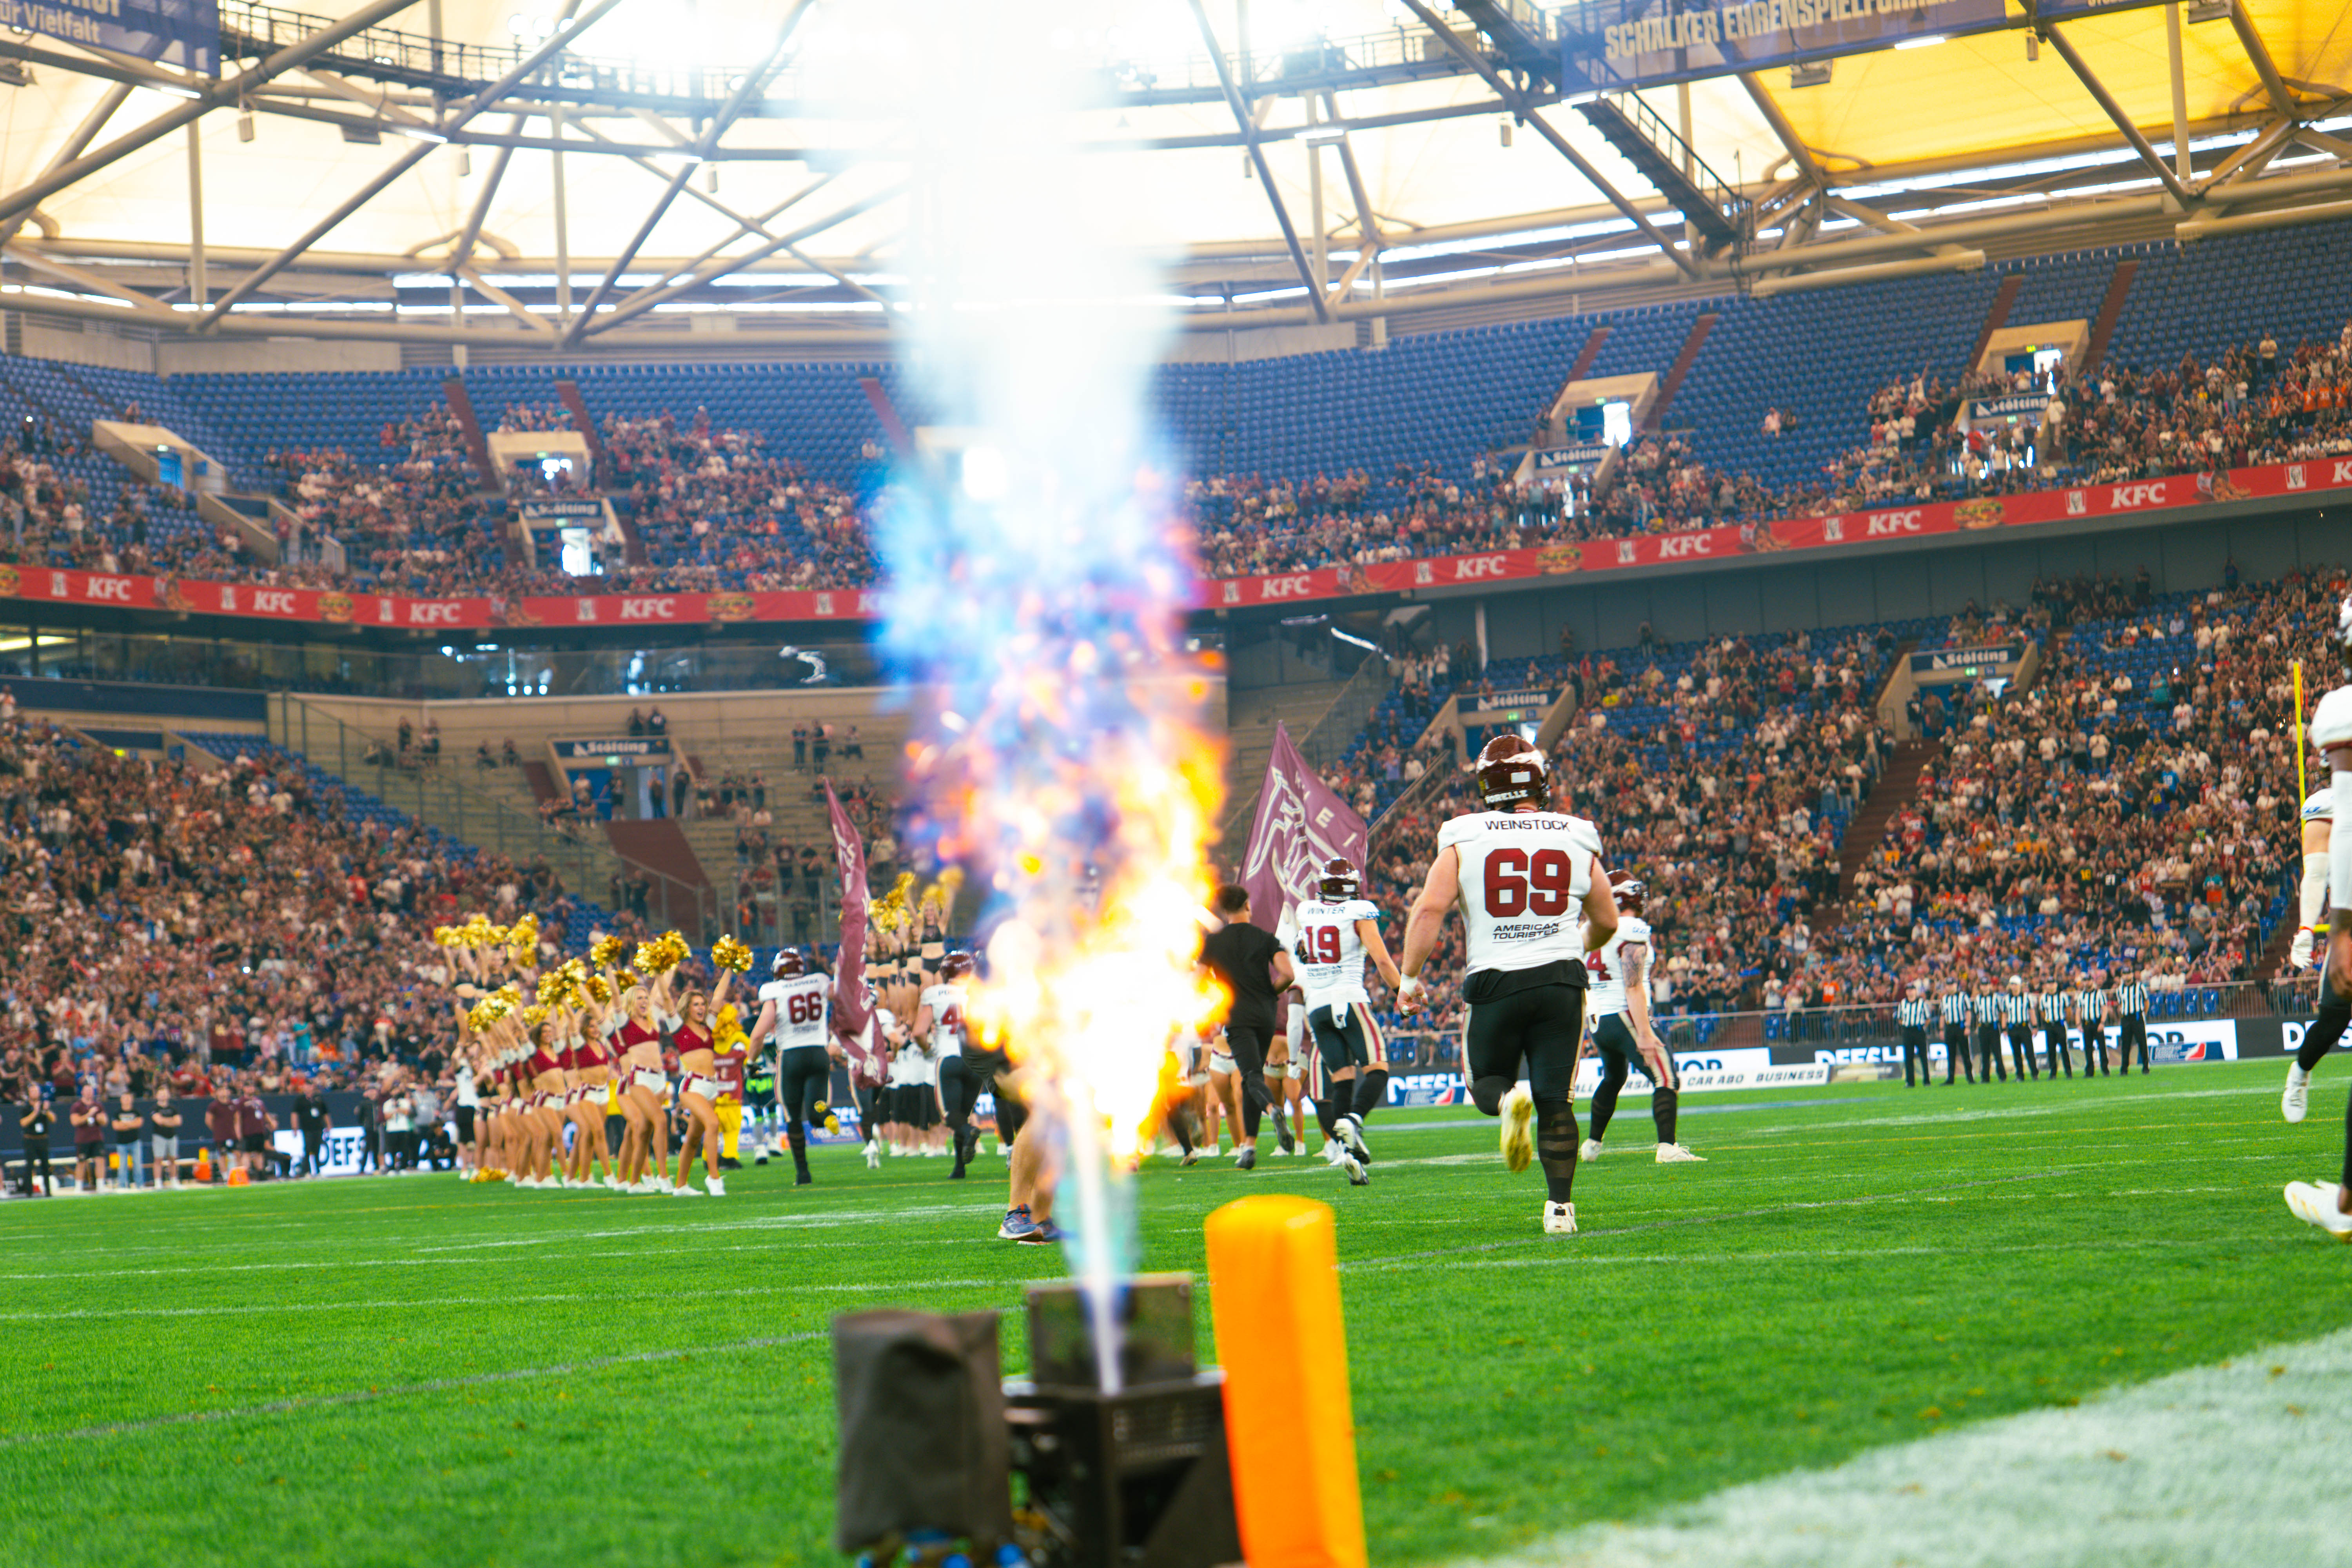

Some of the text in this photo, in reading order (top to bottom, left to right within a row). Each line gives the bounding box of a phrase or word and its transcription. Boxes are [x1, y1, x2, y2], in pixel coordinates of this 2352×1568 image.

[23, 2, 101, 44] Vielfalt
[1604, 9, 1720, 59] SCHALKER
[2111, 482, 2166, 509] KFC
[1867, 510, 1921, 535] KFC
[1659, 534, 1711, 557] KFC
[1455, 555, 1506, 579] KFC
[87, 577, 132, 601] KFC
[1261, 575, 1310, 599] KFC
[253, 590, 296, 613] KFC
[410, 603, 462, 624] KFC
[621, 598, 676, 619] KFC
[1485, 820, 1570, 832] WEINSTOCK
[1484, 848, 1571, 918] 69
[1493, 928, 1559, 940] TOURISTER
[1494, 923, 1559, 932] AMERICAN
[1305, 925, 1341, 964] 19
[788, 992, 822, 1024] 66
[1688, 1069, 1824, 1086] CAR ABO BUSINESS
